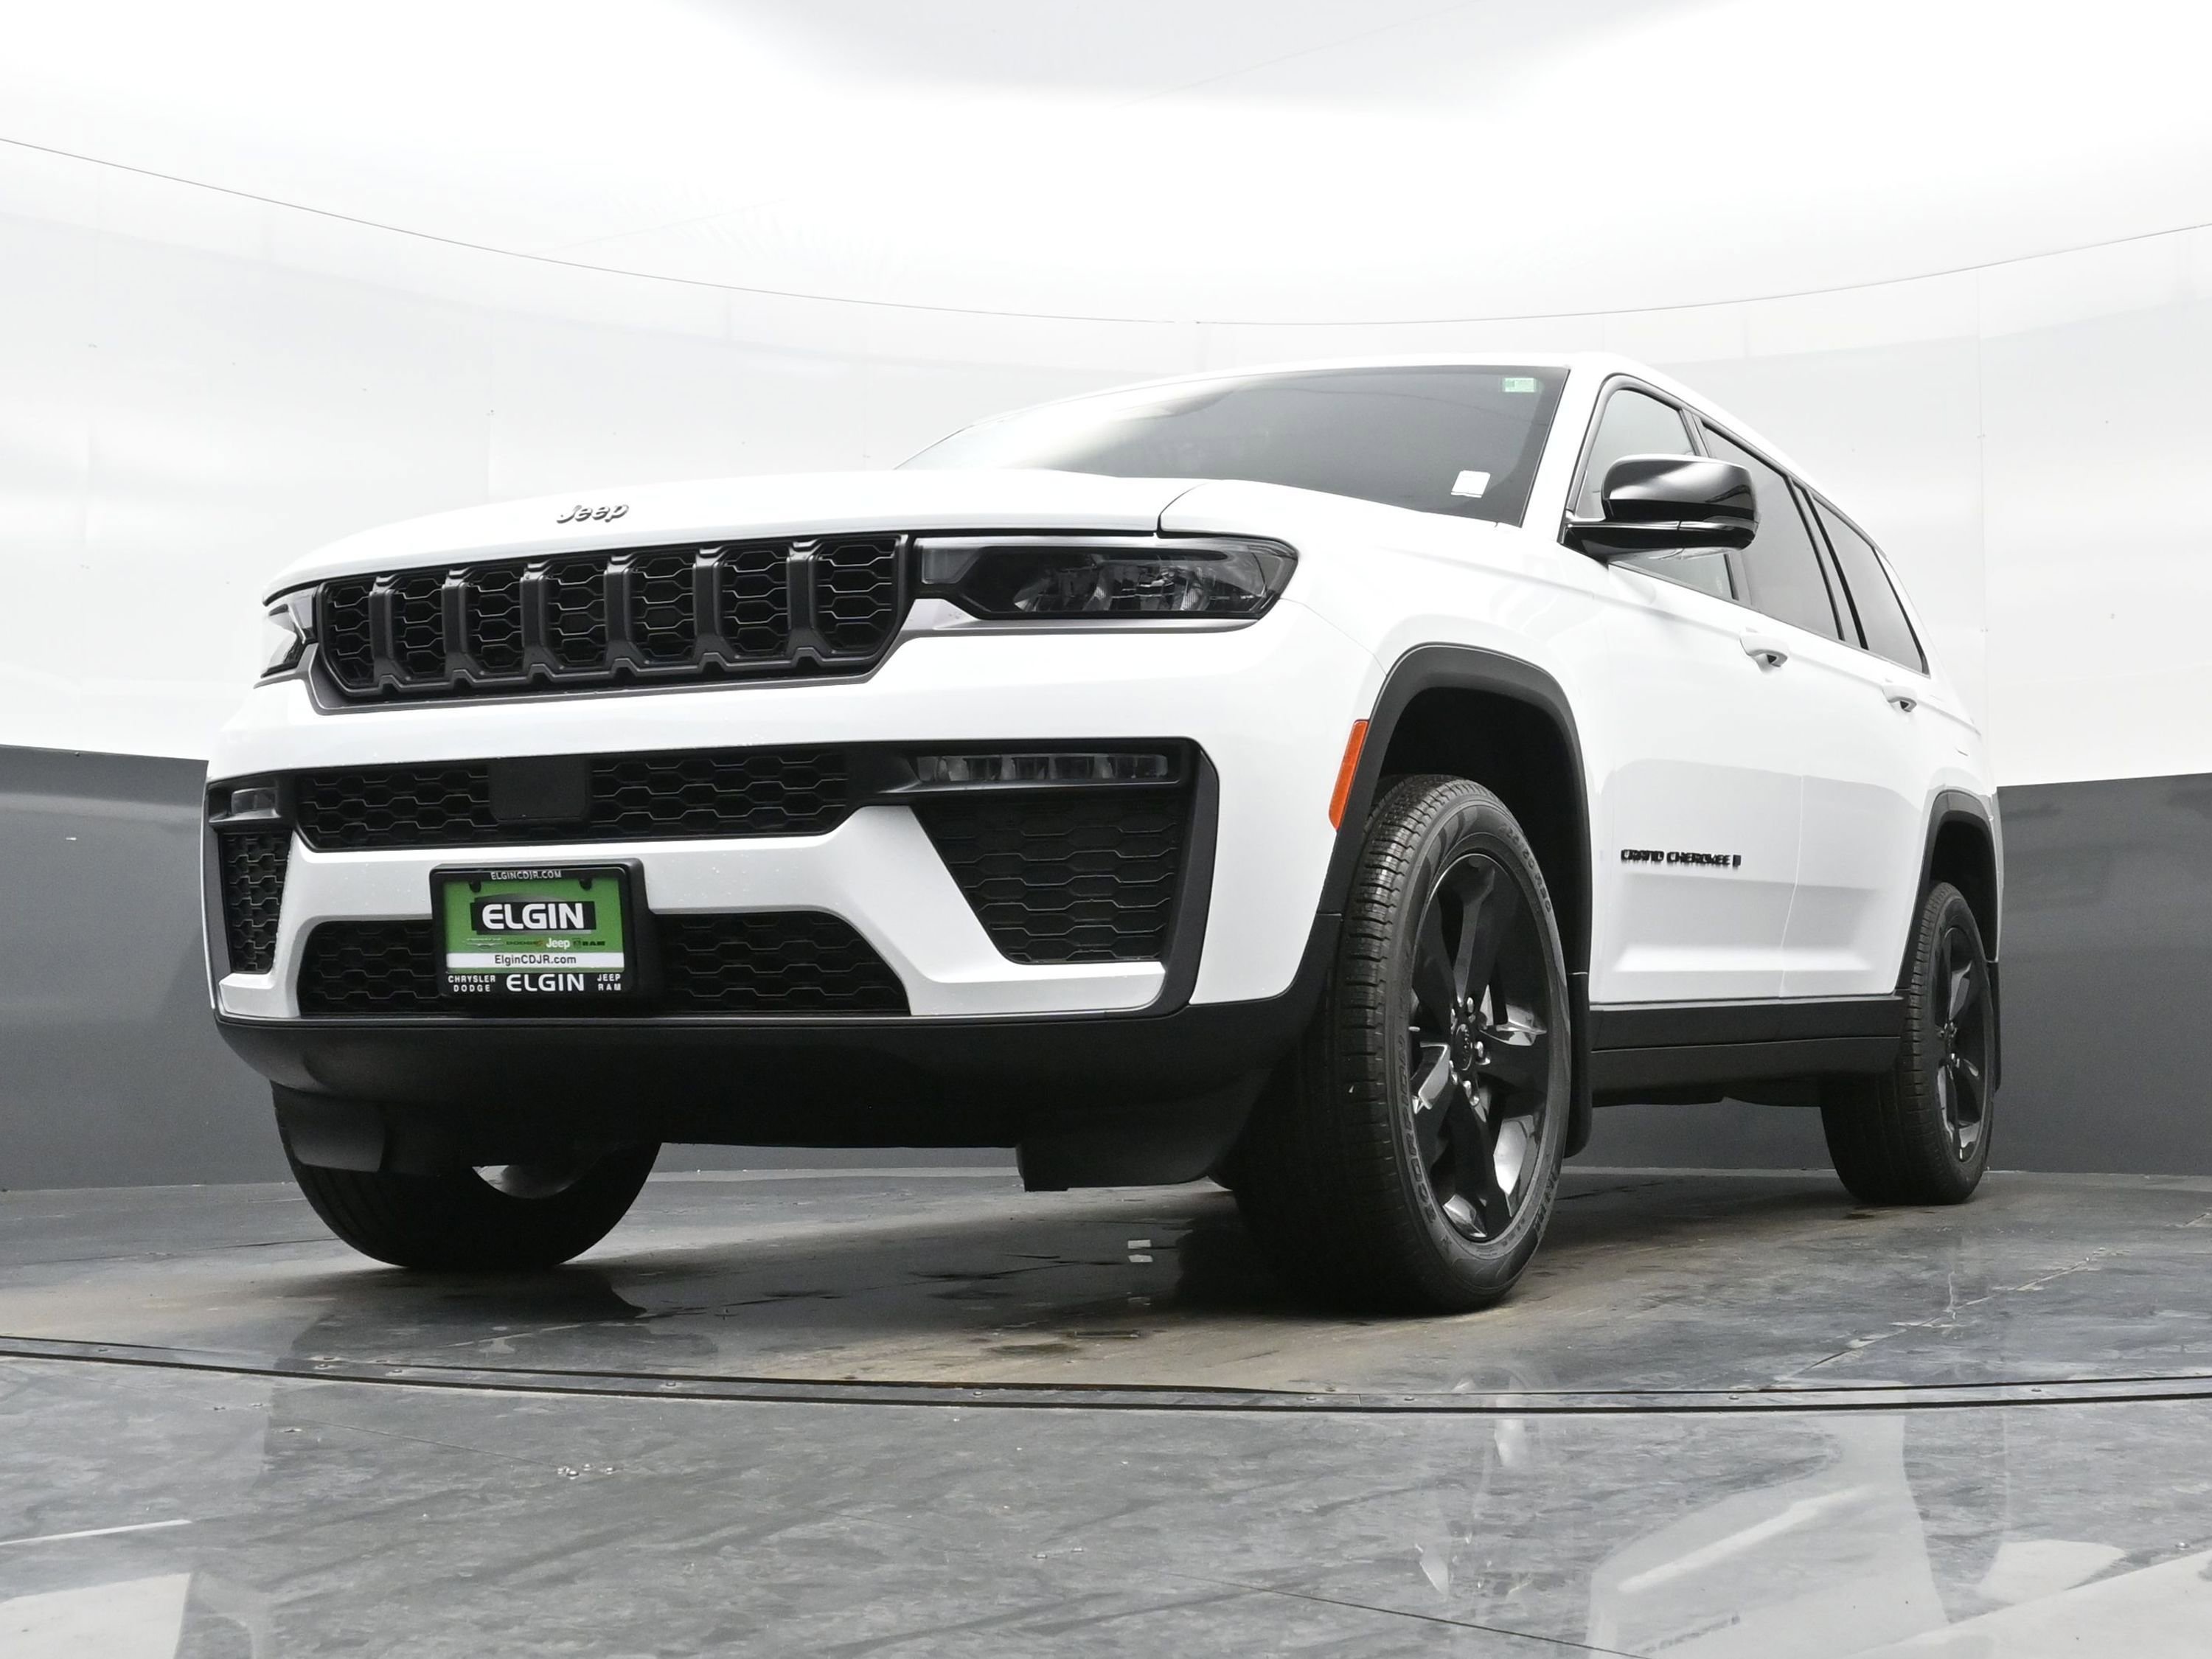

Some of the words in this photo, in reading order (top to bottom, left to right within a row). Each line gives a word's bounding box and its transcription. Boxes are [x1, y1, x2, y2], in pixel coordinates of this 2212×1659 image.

[557, 504, 629, 524] Jeep
[490, 869, 562, 880] ELGINCDJR.COM
[481, 902, 584, 930] ELGIN
[546, 937, 570, 950] Jeep
[495, 954, 577, 967] ElginCDJR.com
[448, 975, 496, 984] CHRYSLER
[506, 973, 585, 992] ELGIN
[597, 973, 621, 982] JEEP
[453, 984, 491, 992] DODGE
[598, 983, 622, 991] RAM
